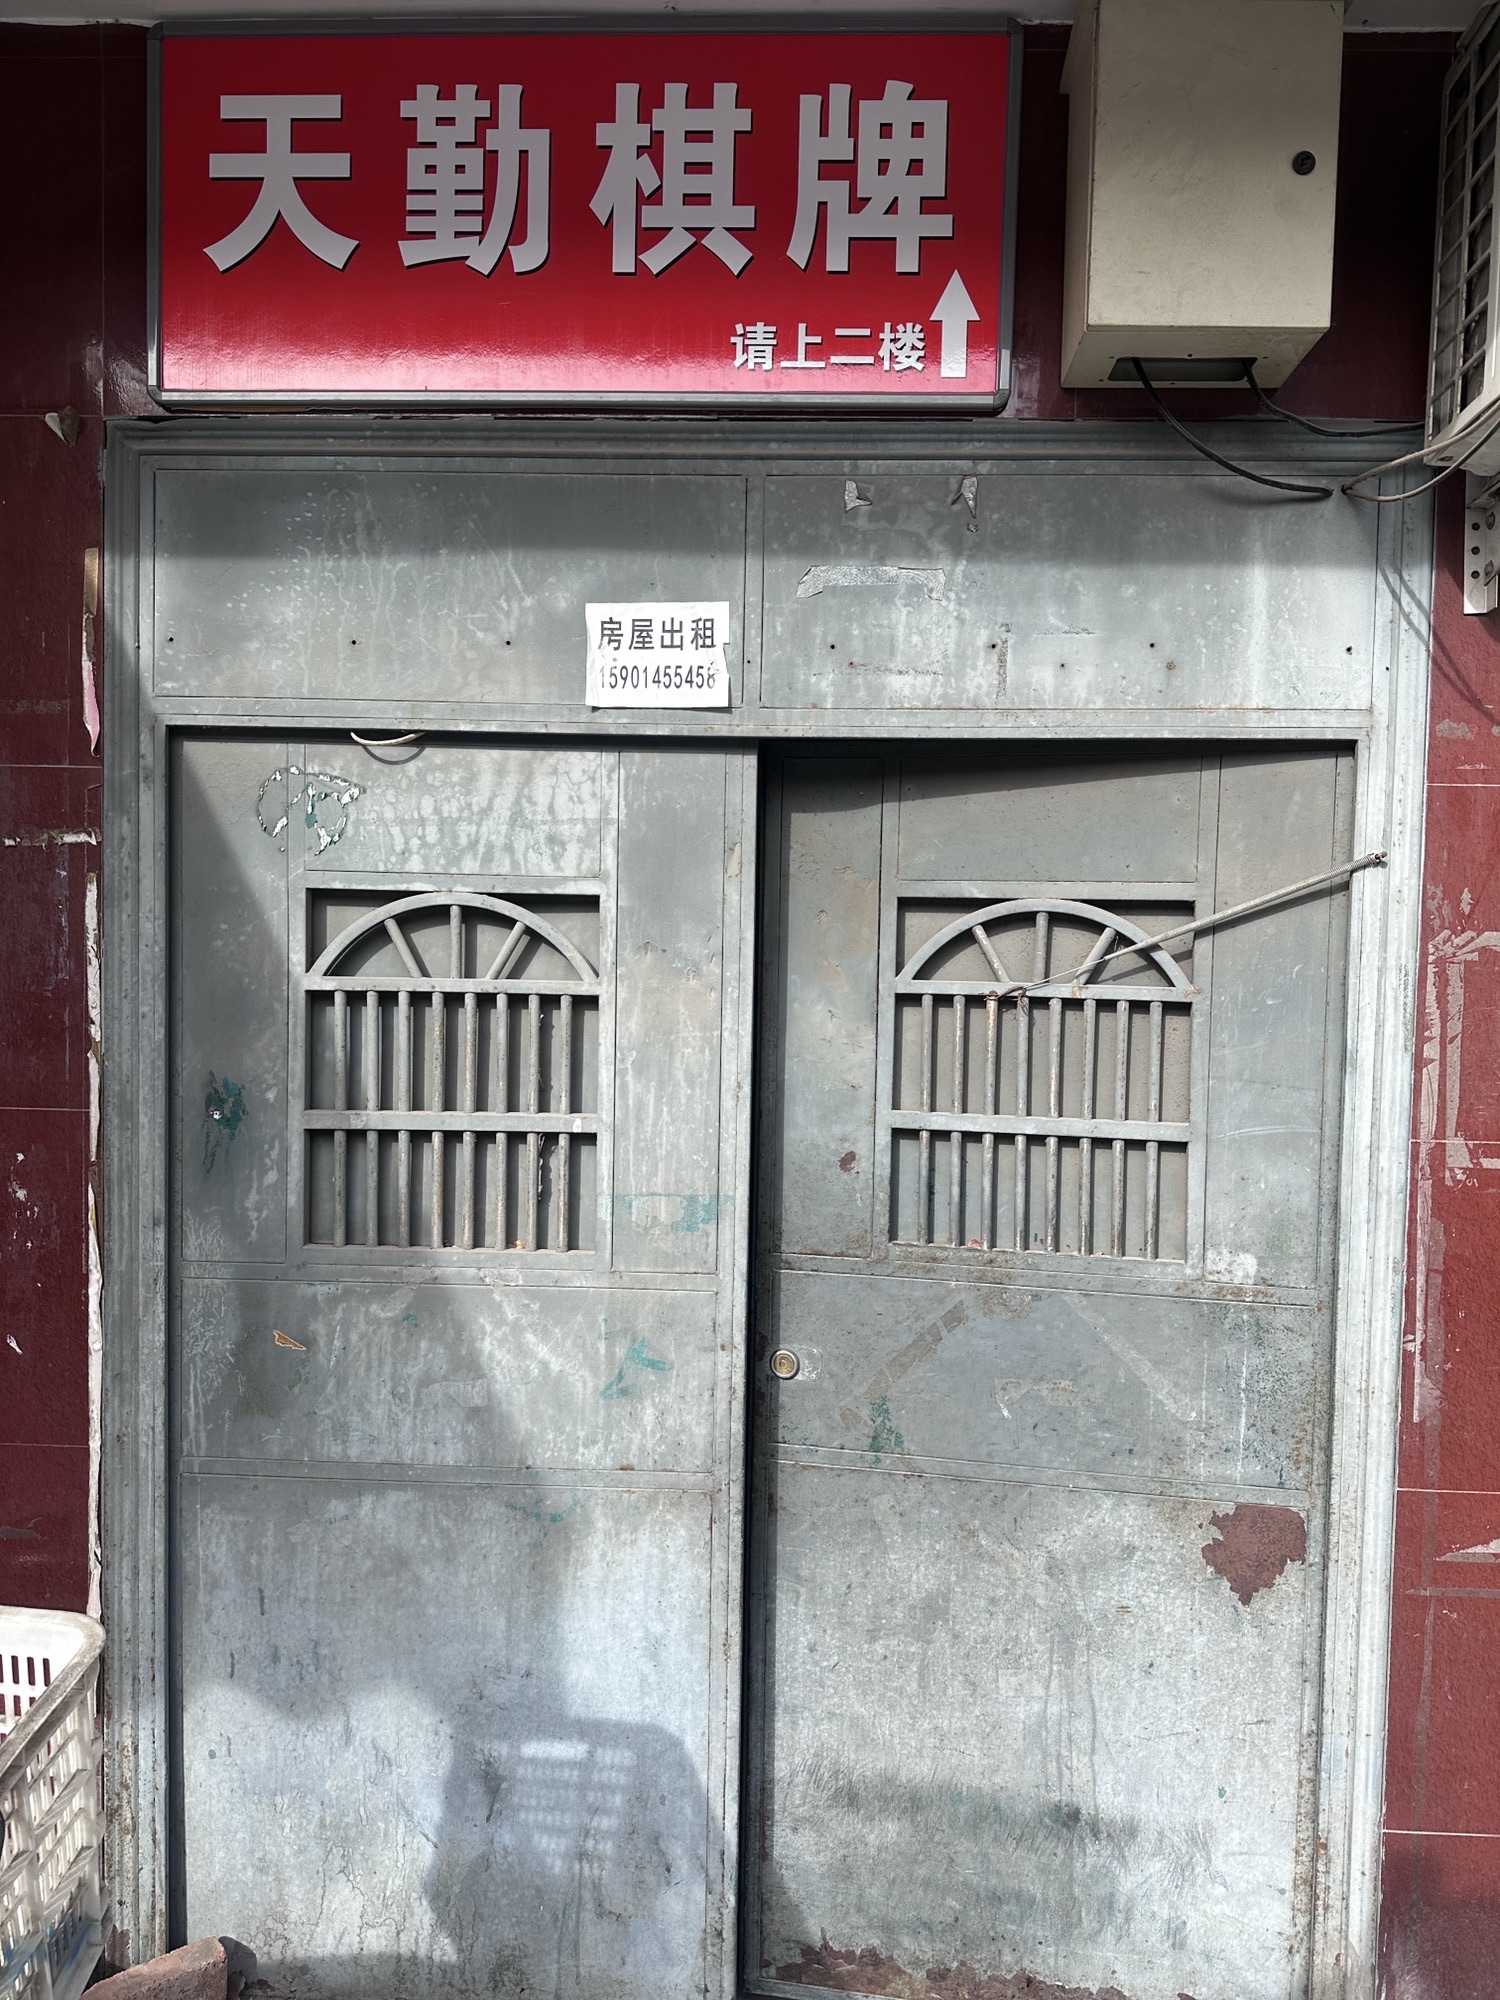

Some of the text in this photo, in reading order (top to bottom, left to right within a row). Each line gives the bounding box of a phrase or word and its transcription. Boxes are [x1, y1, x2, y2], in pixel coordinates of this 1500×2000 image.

[203, 80, 954, 276] 天勤棋牌
[730, 322, 925, 372] 请上二楼
[598, 617, 716, 651] 房屋出租
